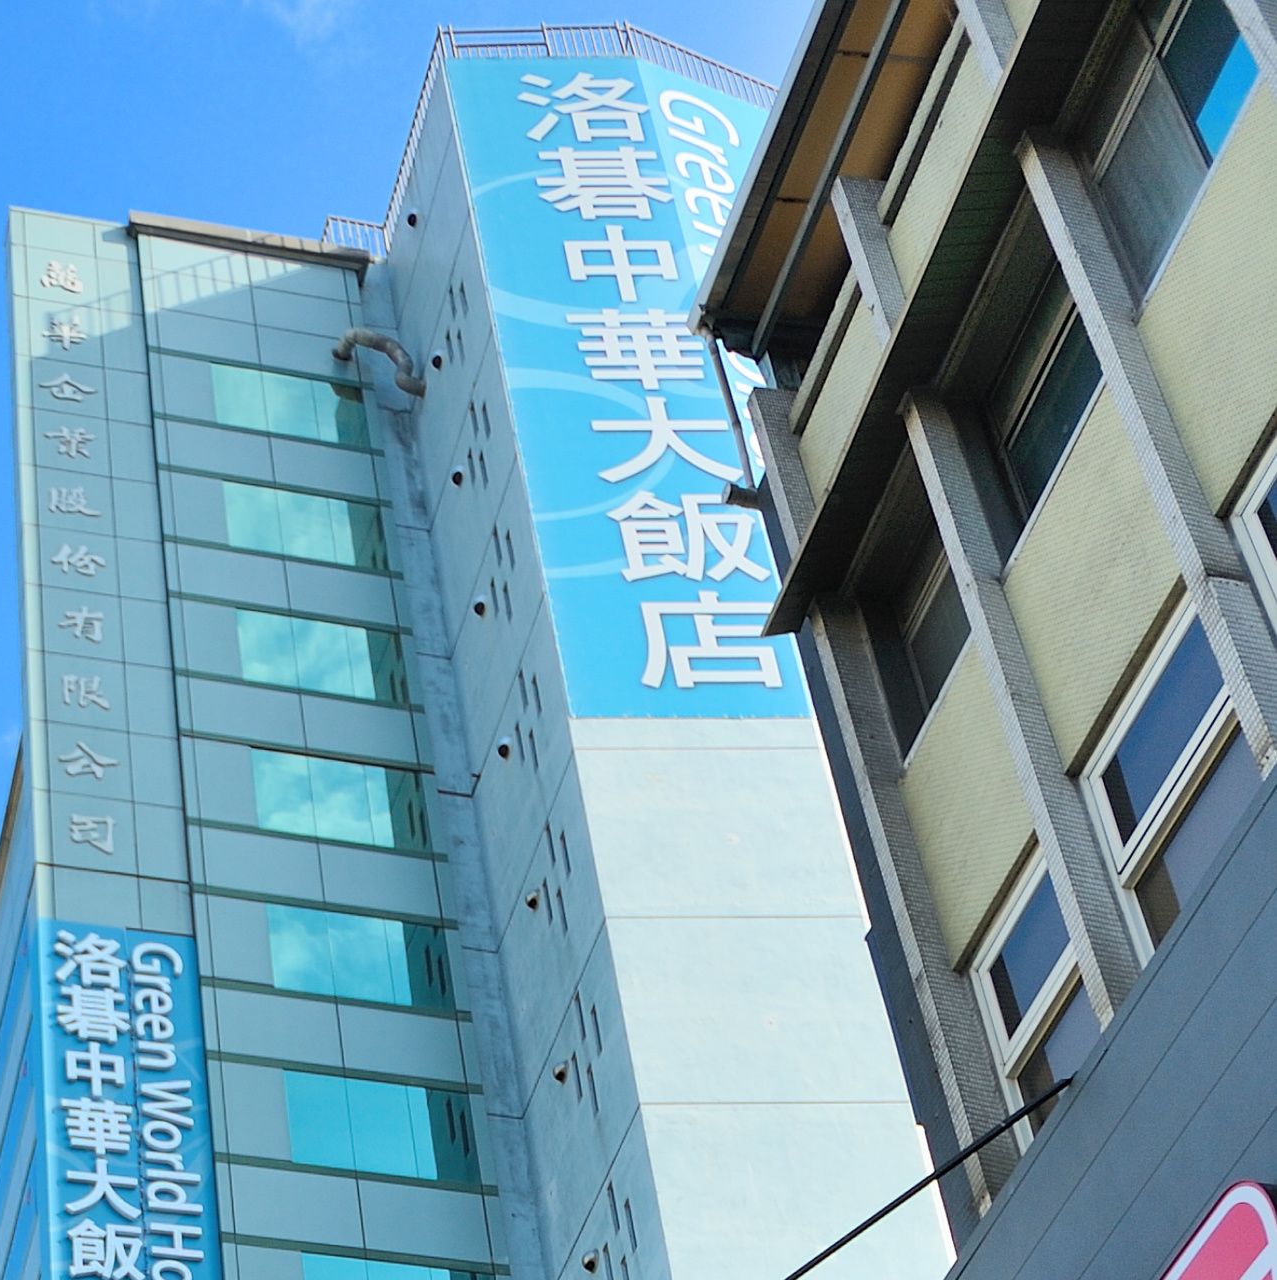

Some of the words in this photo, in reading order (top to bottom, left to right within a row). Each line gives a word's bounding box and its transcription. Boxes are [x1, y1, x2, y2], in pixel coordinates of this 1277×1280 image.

[517, 72, 784, 690] 洛碁中華大飯店
[131, 941, 183, 1071] Green
[140, 1080, 204, 1216] World
